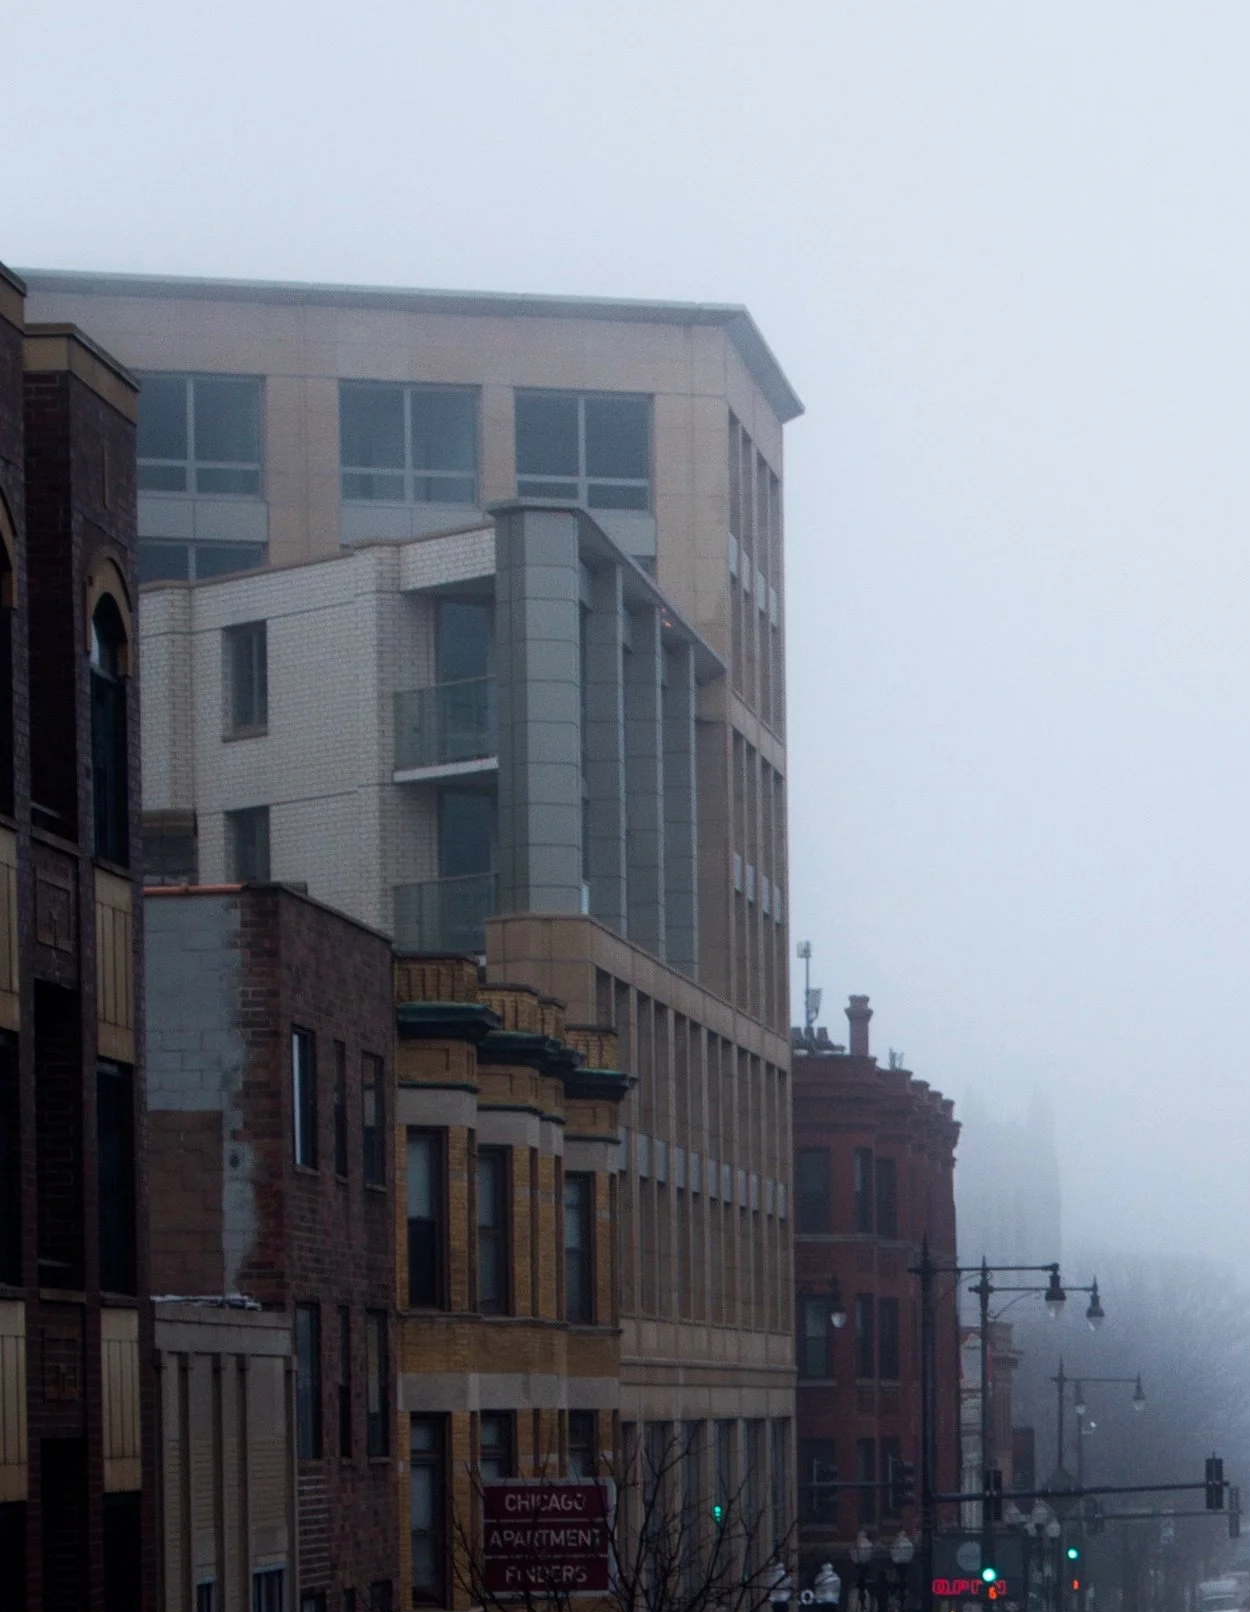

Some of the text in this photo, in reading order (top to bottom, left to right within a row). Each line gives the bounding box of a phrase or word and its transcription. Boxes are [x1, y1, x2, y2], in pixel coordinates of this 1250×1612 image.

[504, 1493, 587, 1512] CHICAGO
[488, 1528, 602, 1548] APARTMENT
[504, 1564, 588, 1584] FINDERS
